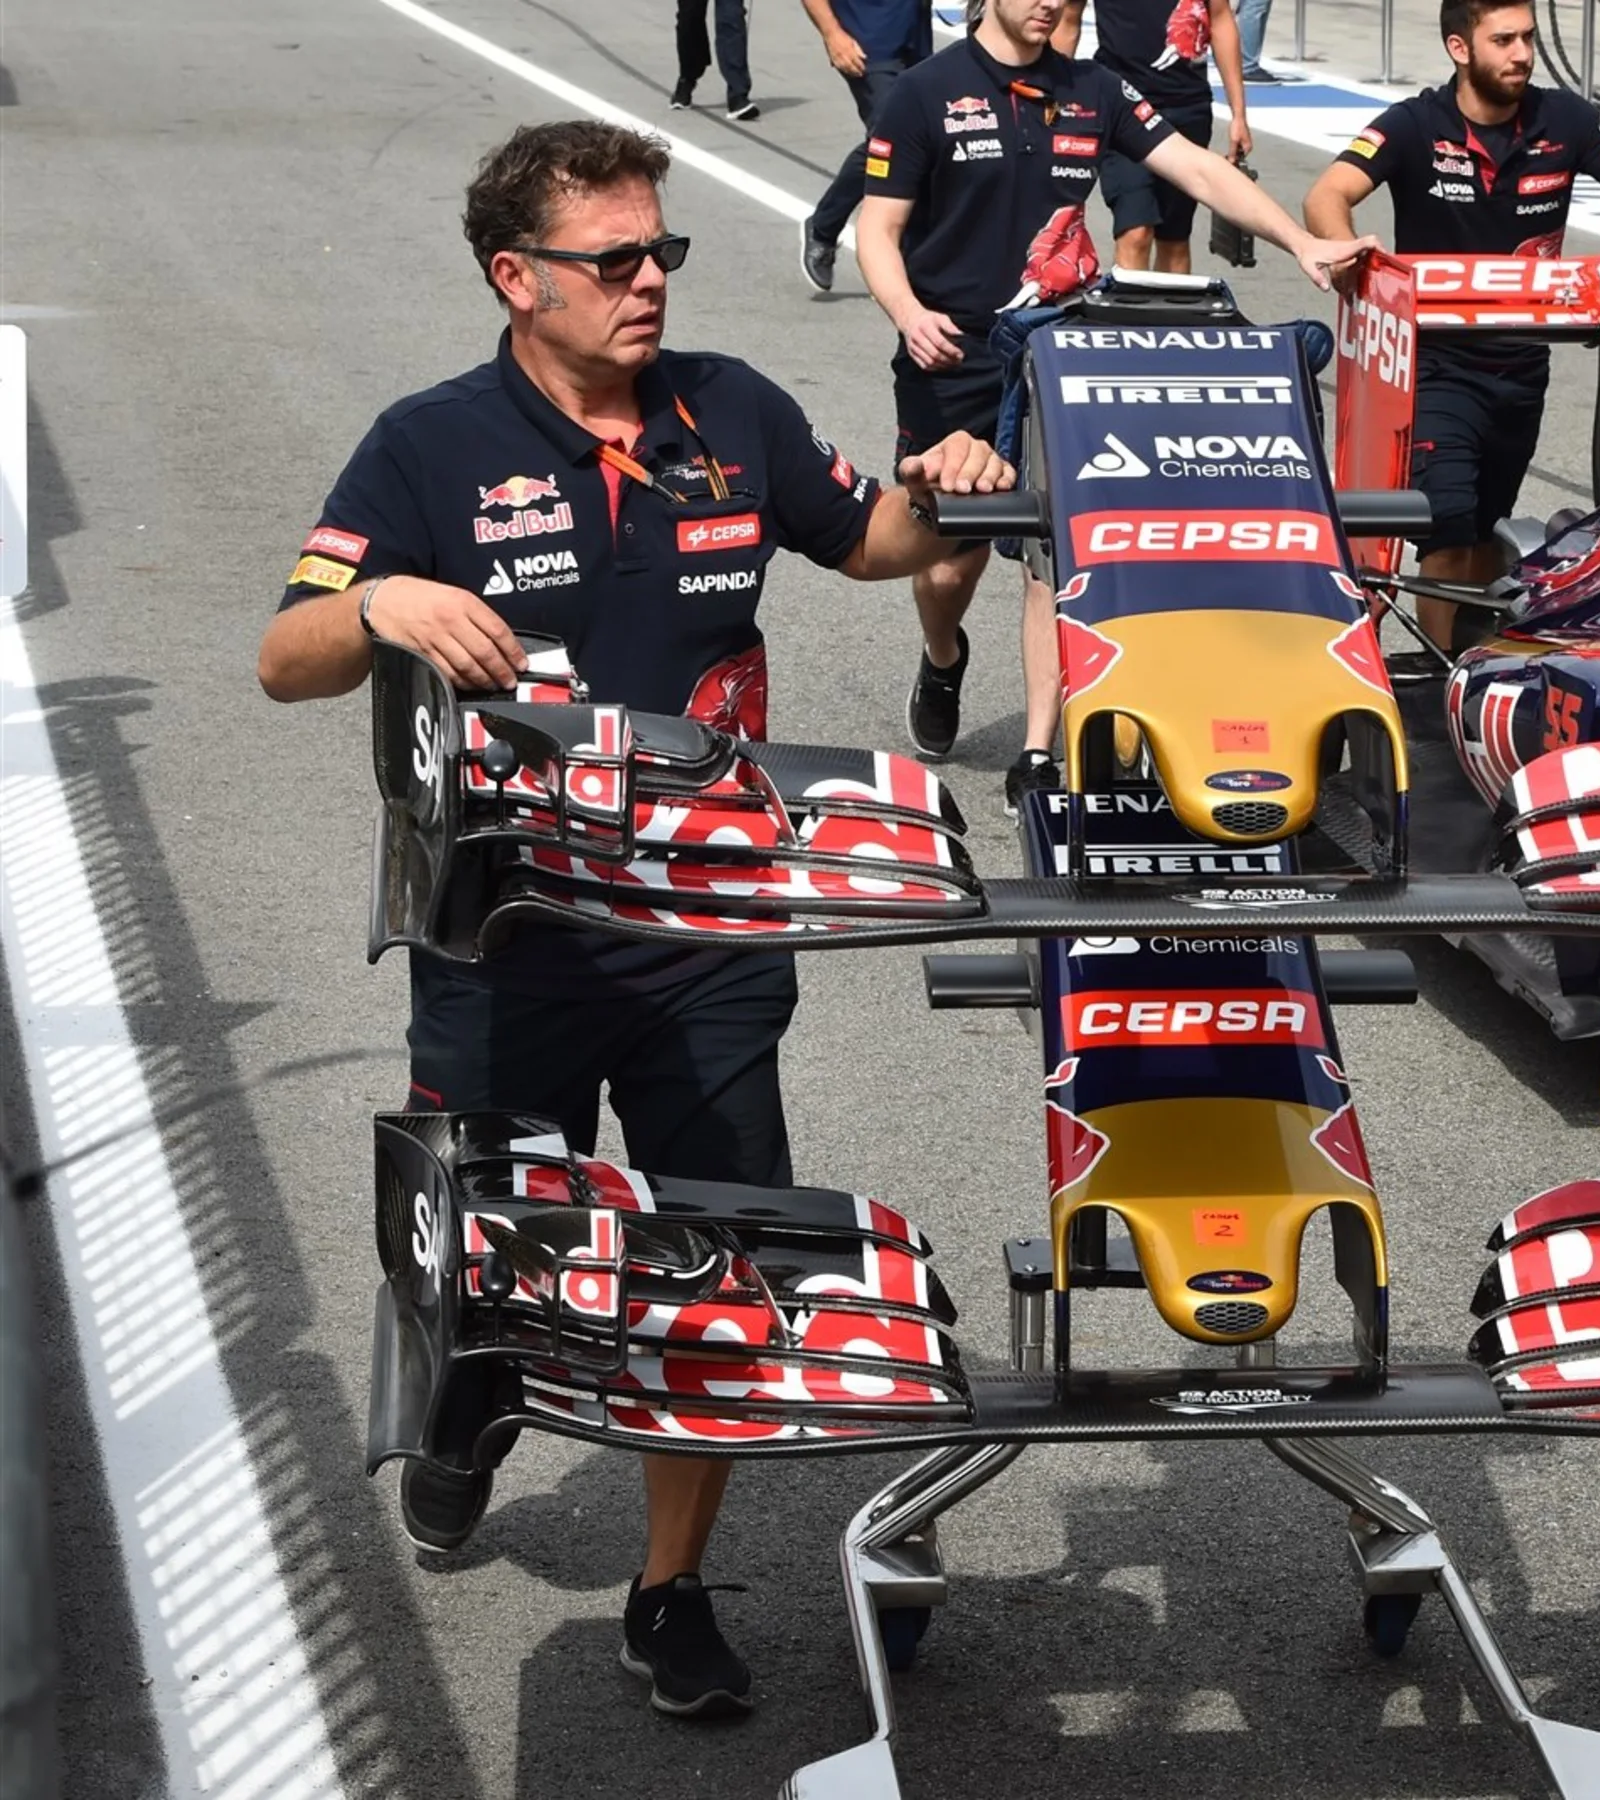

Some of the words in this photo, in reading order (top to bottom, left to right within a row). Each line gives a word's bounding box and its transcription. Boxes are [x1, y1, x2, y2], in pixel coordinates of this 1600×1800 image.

[966, 138, 1002, 152] NOVA
[1053, 331, 1281, 350] RENAULT
[1060, 376, 1293, 404] PIRELLI
[1155, 435, 1307, 460] NOVA
[1159, 461, 1312, 480] Chemicals
[473, 510, 526, 545] Red
[523, 501, 574, 537] Bull
[712, 522, 756, 542] CEPSA
[1089, 521, 1320, 553] CEPSA
[514, 550, 579, 577] NOVA
[516, 570, 581, 592] Chemicals
[678, 570, 757, 594] SAPINDA
[1543, 685, 1583, 750] 55
[1053, 844, 1282, 875] PIRELLI
[1149, 934, 1299, 956] Chemicals
[1078, 1001, 1307, 1036] CEPSA
[1213, 1225, 1235, 1237] 2
[1206, 1396, 1250, 1404] ROAD
[1252, 1395, 1312, 1403] SAFETY
[1209, 1389, 1283, 1398] ACTION
